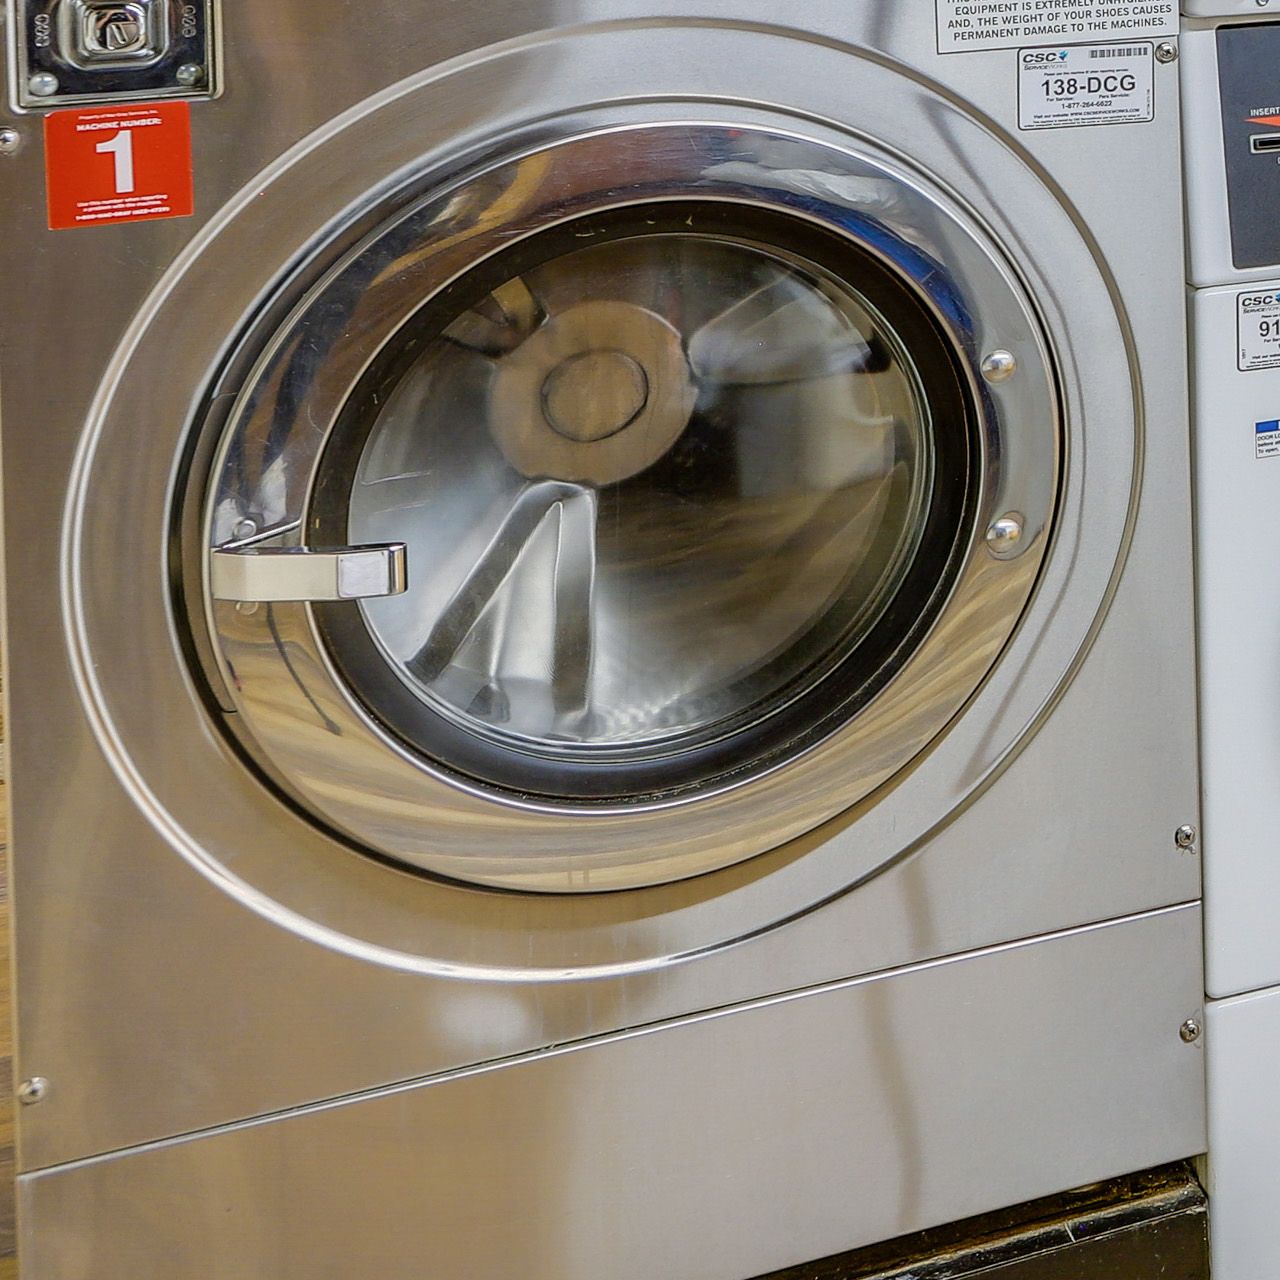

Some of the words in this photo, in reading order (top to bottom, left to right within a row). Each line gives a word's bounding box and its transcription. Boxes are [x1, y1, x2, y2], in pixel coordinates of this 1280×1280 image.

[955, 3, 1018, 16] EQUIPMENT
[1022, 2, 1031, 11] IS
[948, 20, 973, 29] AND,
[978, 18, 998, 27] THE
[1002, 14, 1043, 25] WEIGHT
[1047, 12, 1060, 21] OF
[1064, 10, 1092, 20] YOUR
[1096, 8, 1129, 18] SHOES
[1133, 5, 1171, 15] CAUSES
[954, 28, 1020, 41] PERMANENT
[1024, 25, 1067, 36] DAMAGE
[1071, 23, 1084, 32] TO
[1088, 21, 1107, 31] THE
[1111, 17, 1167, 29] MACHINES.
[1023, 52, 1057, 63] CSC
[1042, 75, 1135, 96] 138-DCG
[1250, 107, 1280, 117] INSERT
[77, 121, 119, 131] MACHINE
[96, 130, 134, 193] 1
[1242, 295, 1273, 306] CSC
